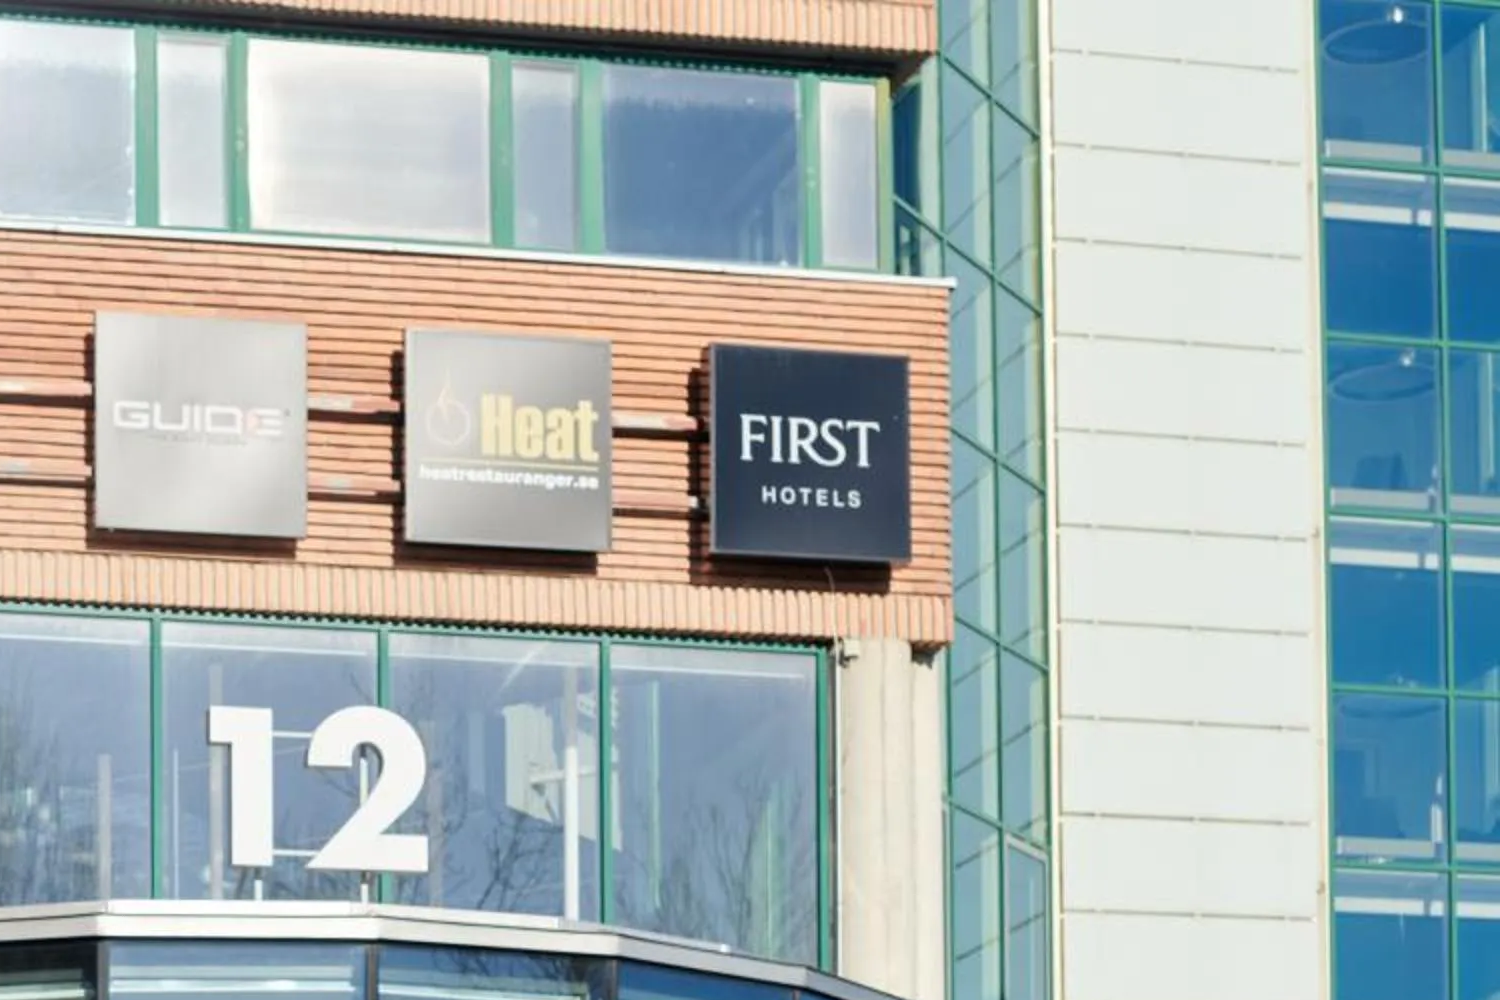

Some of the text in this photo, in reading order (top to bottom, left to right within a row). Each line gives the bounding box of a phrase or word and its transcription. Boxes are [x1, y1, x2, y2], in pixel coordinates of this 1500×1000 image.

[113, 399, 284, 437] GUIDE
[481, 393, 599, 462] Heat
[739, 413, 881, 468] FIRST
[761, 485, 862, 509] HOTELS
[209, 705, 429, 873] 12
